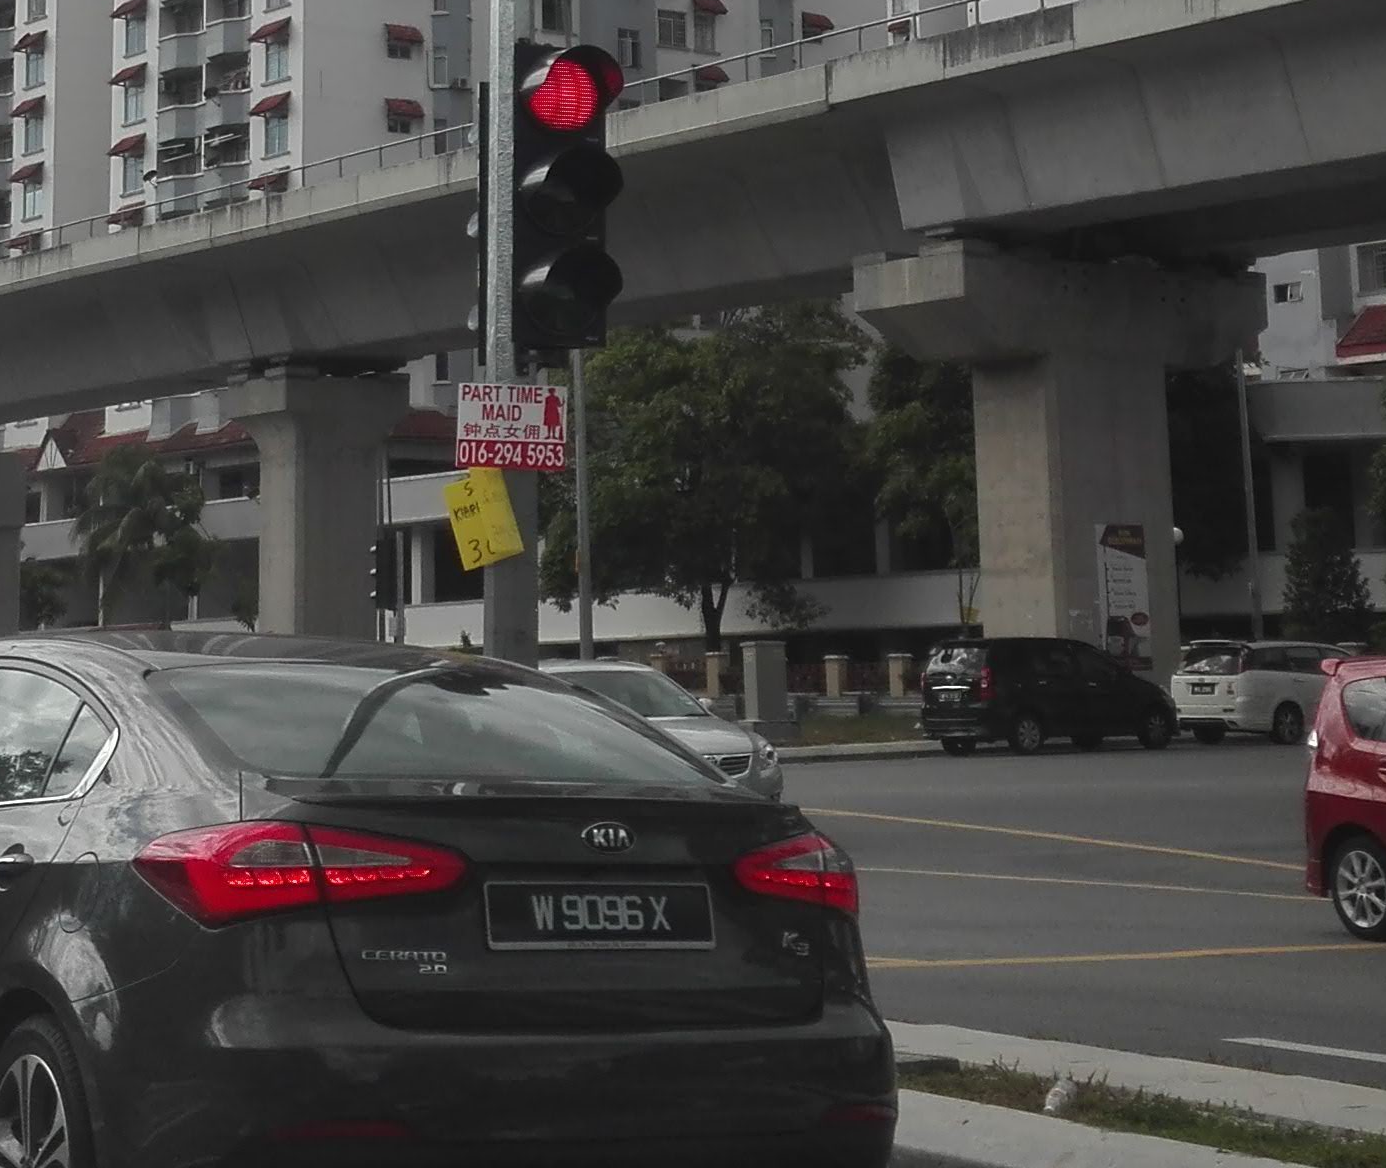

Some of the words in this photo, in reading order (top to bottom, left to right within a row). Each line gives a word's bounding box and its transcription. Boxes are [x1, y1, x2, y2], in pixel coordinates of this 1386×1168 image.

[462, 386, 502, 401] PART
[507, 386, 543, 404] TIME
[482, 404, 522, 421] MAID
[463, 423, 540, 440] 钟点女佣
[459, 442, 522, 465] 016-294
[527, 445, 564, 467] 5953
[592, 828, 630, 847] KIA
[531, 895, 554, 931] W
[561, 895, 644, 931] 9096
[648, 896, 672, 931] X
[361, 949, 447, 962] CERATO
